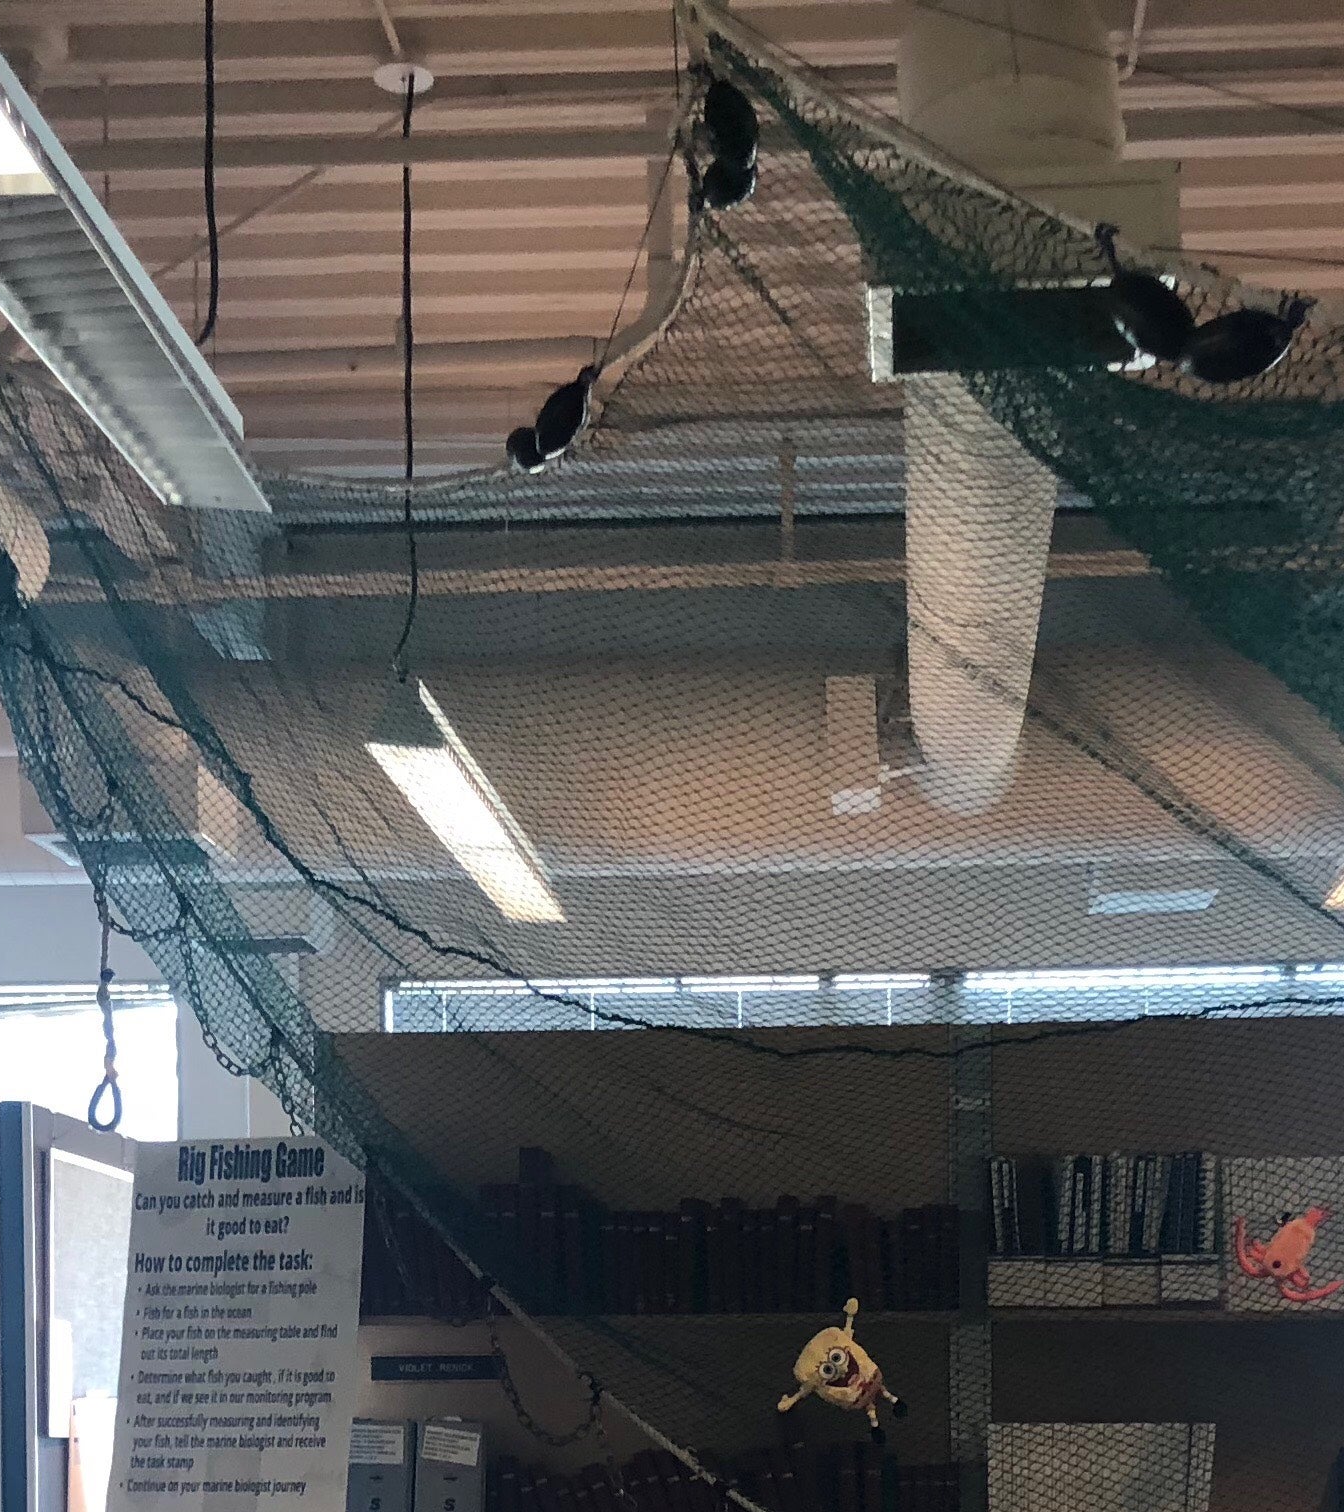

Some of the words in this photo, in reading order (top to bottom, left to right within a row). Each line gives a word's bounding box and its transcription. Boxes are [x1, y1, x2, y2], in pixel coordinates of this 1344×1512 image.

[209, 1144, 273, 1183] Fishing
[275, 1141, 325, 1178] Game
[135, 1193, 157, 1210] Can
[159, 1195, 180, 1215] you
[183, 1190, 214, 1209] catch
[218, 1189, 240, 1208] and
[242, 1192, 292, 1207] measure
[296, 1194, 302, 1205] a
[306, 1186, 327, 1206] fish
[329, 1185, 351, 1204] and
[355, 1185, 364, 1204] is
[207, 1218, 215, 1235] it
[218, 1217, 247, 1241] good
[249, 1220, 261, 1234] to
[265, 1216, 289, 1234] eat?
[135, 1253, 165, 1273] How
[168, 1254, 182, 1272] to
[186, 1250, 249, 1278] complete
[253, 1249, 275, 1271] the
[279, 1249, 313, 1270] task:
[145, 1283, 160, 1295] Ask
[163, 1283, 176, 1295] the
[177, 1283, 208, 1295] marine
[210, 1281, 246, 1299] biologist
[248, 1281, 259, 1294] for
[268, 1280, 296, 1298] fishing
[299, 1281, 317, 1297] pole
[143, 1306, 161, 1319] Fish
[163, 1306, 175, 1319] for
[176, 1308, 181, 1319] a
[184, 1304, 199, 1319] fish
[201, 1306, 209, 1319] in
[211, 1304, 225, 1318] the
[227, 1307, 252, 1318] ocean
[141, 1327, 164, 1340] Place
[166, 1329, 185, 1344] your
[187, 1326, 203, 1340] fish
[205, 1328, 216, 1339] on
[218, 1326, 231, 1339] the
[233, 1326, 278, 1343] measuring
[279, 1324, 301, 1339] table
[303, 1324, 319, 1338] and
[321, 1324, 338, 1338] find
[141, 1348, 155, 1361] out
[158, 1347, 167, 1360] its
[170, 1347, 189, 1360] total
[191, 1347, 218, 1363] length
[138, 1370, 183, 1384] Determine
[185, 1371, 206, 1383] what
[208, 1369, 224, 1384] fish
[225, 1372, 241, 1387] you
[243, 1371, 272, 1387] caught
[278, 1369, 285, 1383] if
[286, 1369, 292, 1383] it
[295, 1369, 301, 1383] is
[303, 1369, 324, 1386] good
[325, 1371, 335, 1382] to
[156, 1391, 171, 1403] and
[173, 1390, 180, 1404] if
[182, 1393, 193, 1404] we
[195, 1393, 209, 1403] see
[211, 1391, 218, 1403] it
[219, 1391, 228, 1403] in
[230, 1393, 244, 1403] our
[246, 1389, 293, 1407] monitoring
[296, 1391, 332, 1406] program
[134, 1414, 155, 1428] After
[158, 1414, 208, 1431] successfully
[210, 1414, 254, 1430] measuring
[256, 1413, 272, 1428] and
[274, 1414, 320, 1432] identifying
[133, 1437, 154, 1451] your
[156, 1435, 171, 1449] fish,
[175, 1434, 189, 1447] tell
[191, 1434, 205, 1447] the
[207, 1434, 237, 1447] marine
[239, 1434, 276, 1451] biologist
[277, 1434, 293, 1447] and
[295, 1434, 326, 1447] receive
[131, 1456, 145, 1468] the
[147, 1456, 165, 1468] task
[167, 1457, 194, 1471] stamp
[127, 1479, 166, 1492] Continue
[168, 1480, 179, 1492] on
[180, 1480, 200, 1496] your
[202, 1479, 233, 1492] marine
[235, 1479, 271, 1496] biologist
[272, 1478, 306, 1496] journey
